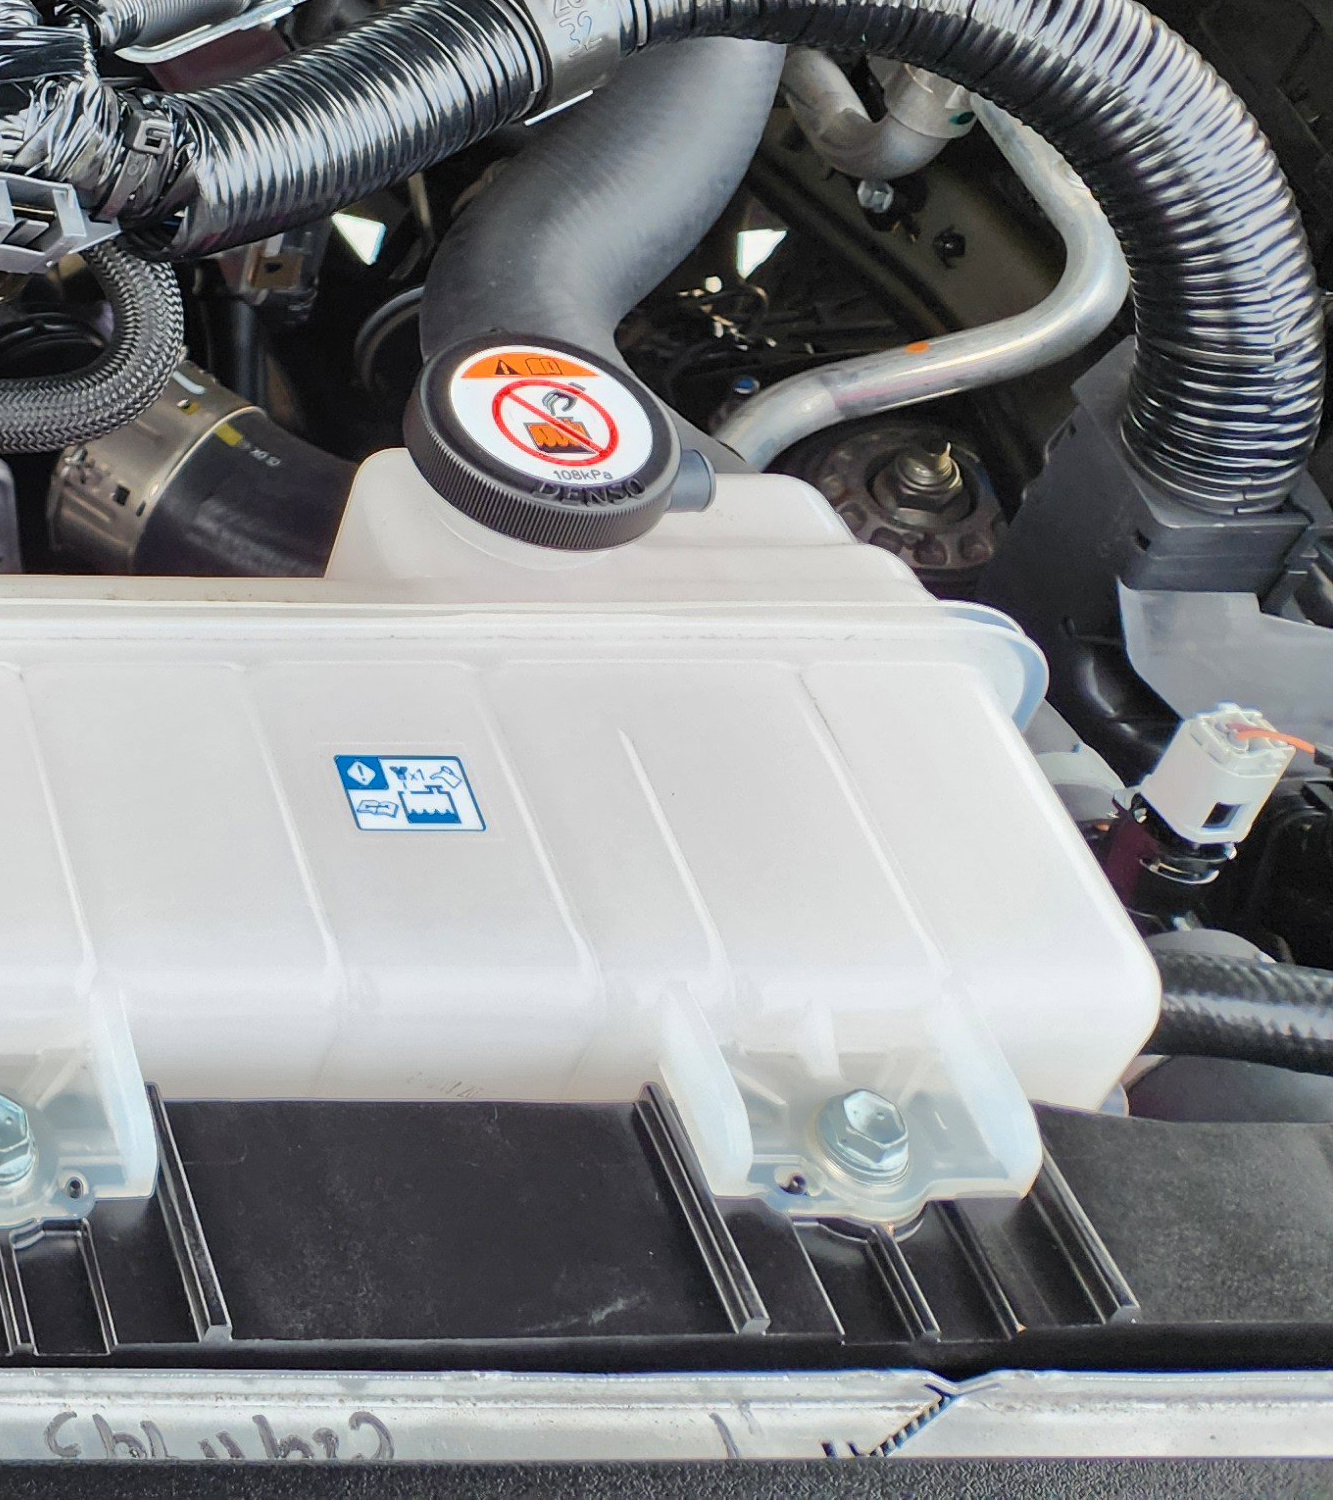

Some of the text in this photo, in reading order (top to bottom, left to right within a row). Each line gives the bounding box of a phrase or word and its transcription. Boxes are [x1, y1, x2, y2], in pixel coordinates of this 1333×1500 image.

[559, 10, 603, 57] 32
[552, 468, 614, 482] 108kPa
[534, 478, 647, 506] DENSO
